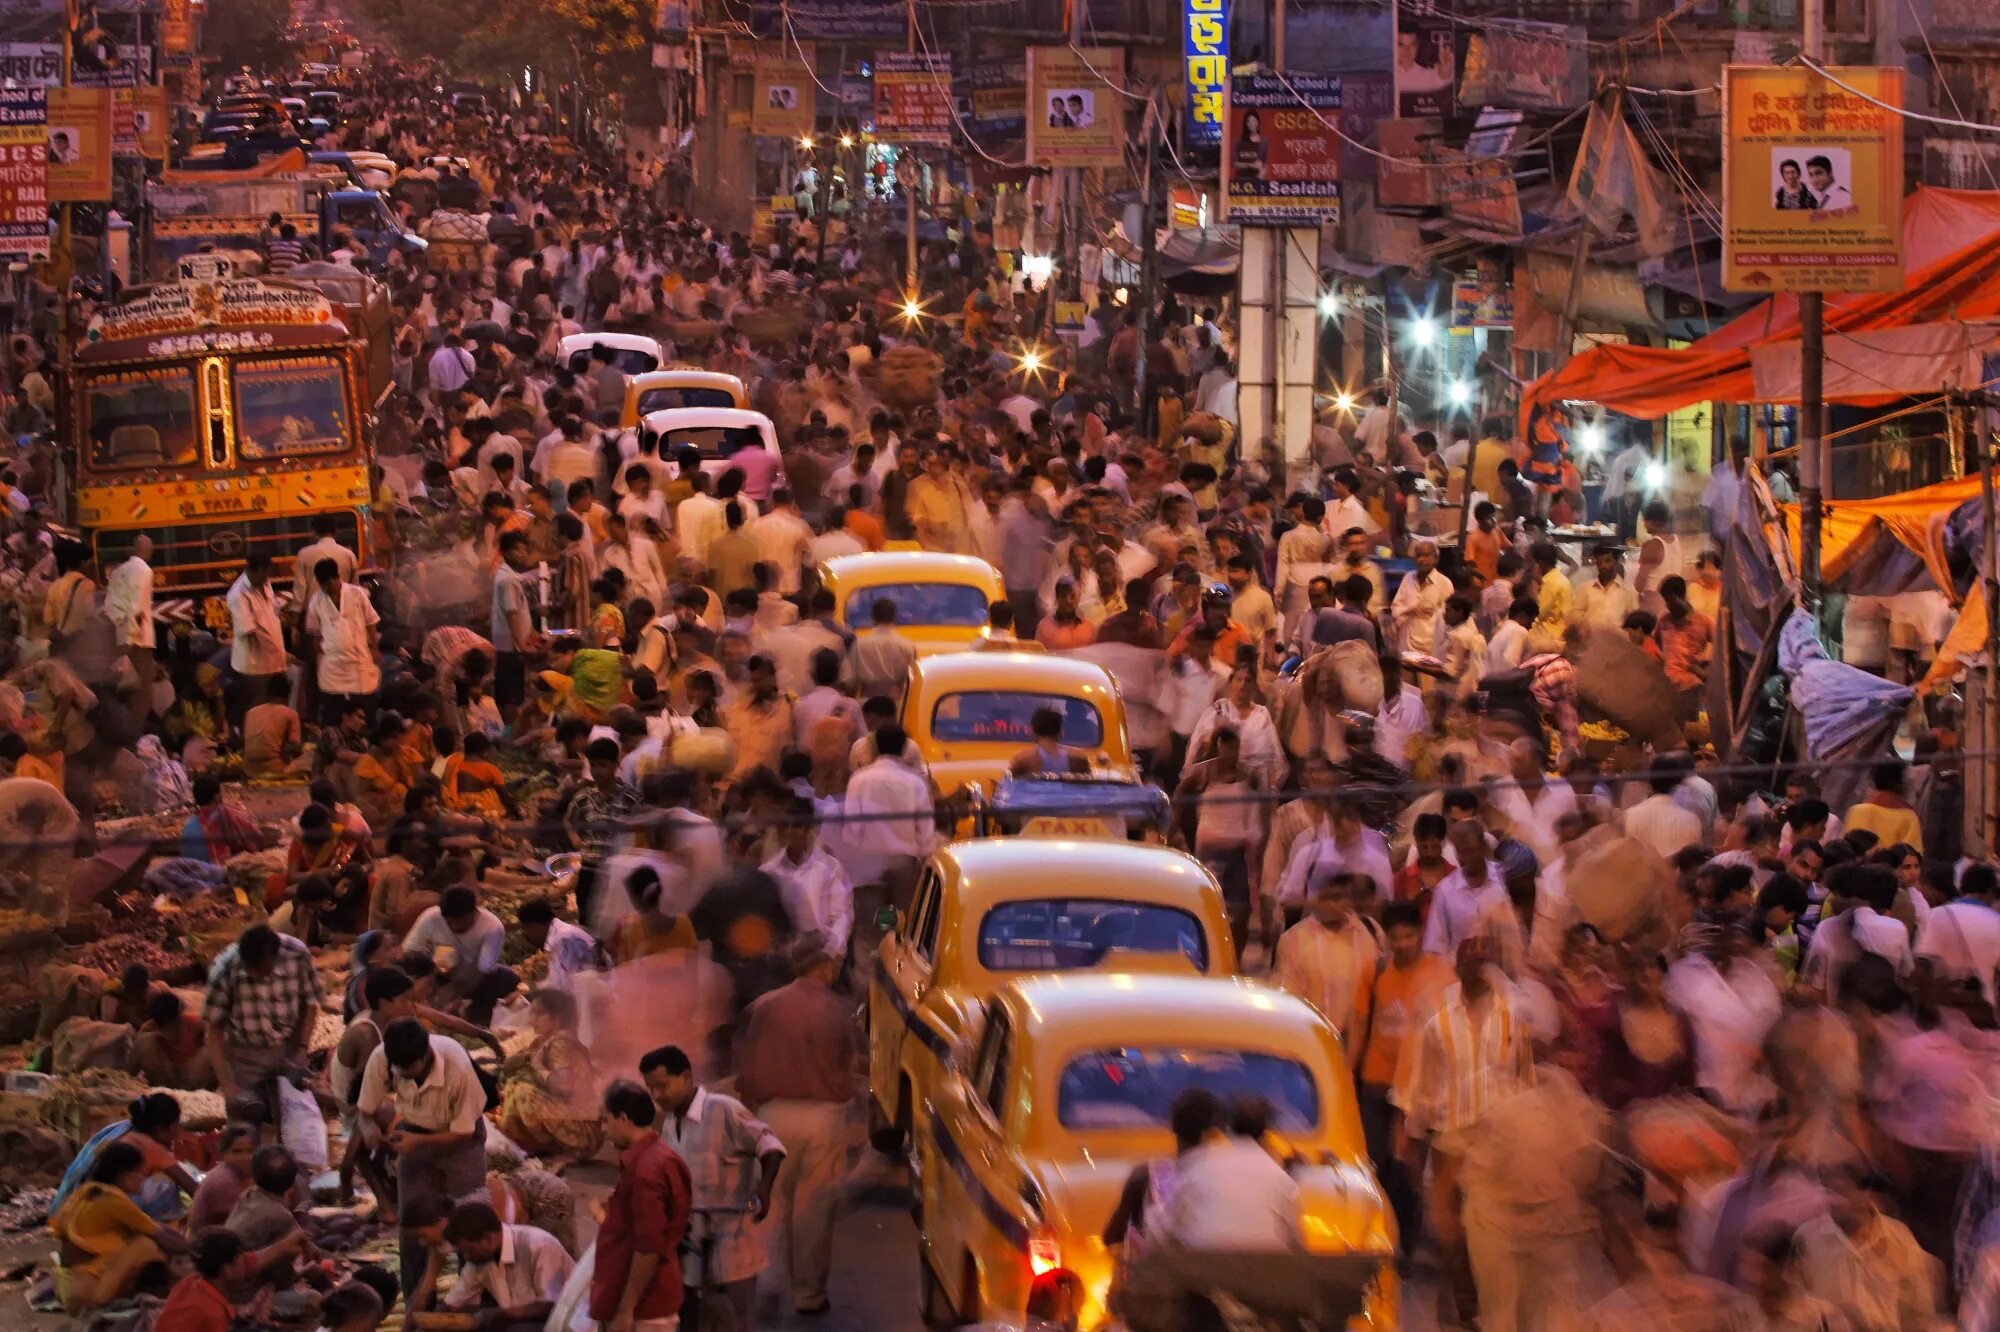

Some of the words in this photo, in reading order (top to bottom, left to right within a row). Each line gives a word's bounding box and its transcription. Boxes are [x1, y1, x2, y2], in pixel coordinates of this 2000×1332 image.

[1293, 76, 1326, 89] School
[1330, 76, 1341, 89] of
[0, 87, 28, 103] hool
[32, 86, 45, 102] of
[0, 107, 46, 121] Exams
[17, 186, 47, 202] RAIL
[1268, 180, 1338, 195] Sealdah
[16, 206, 47, 222] CDS
[202, 497, 245, 513] TATA
[1036, 821, 1099, 834] TAXI
